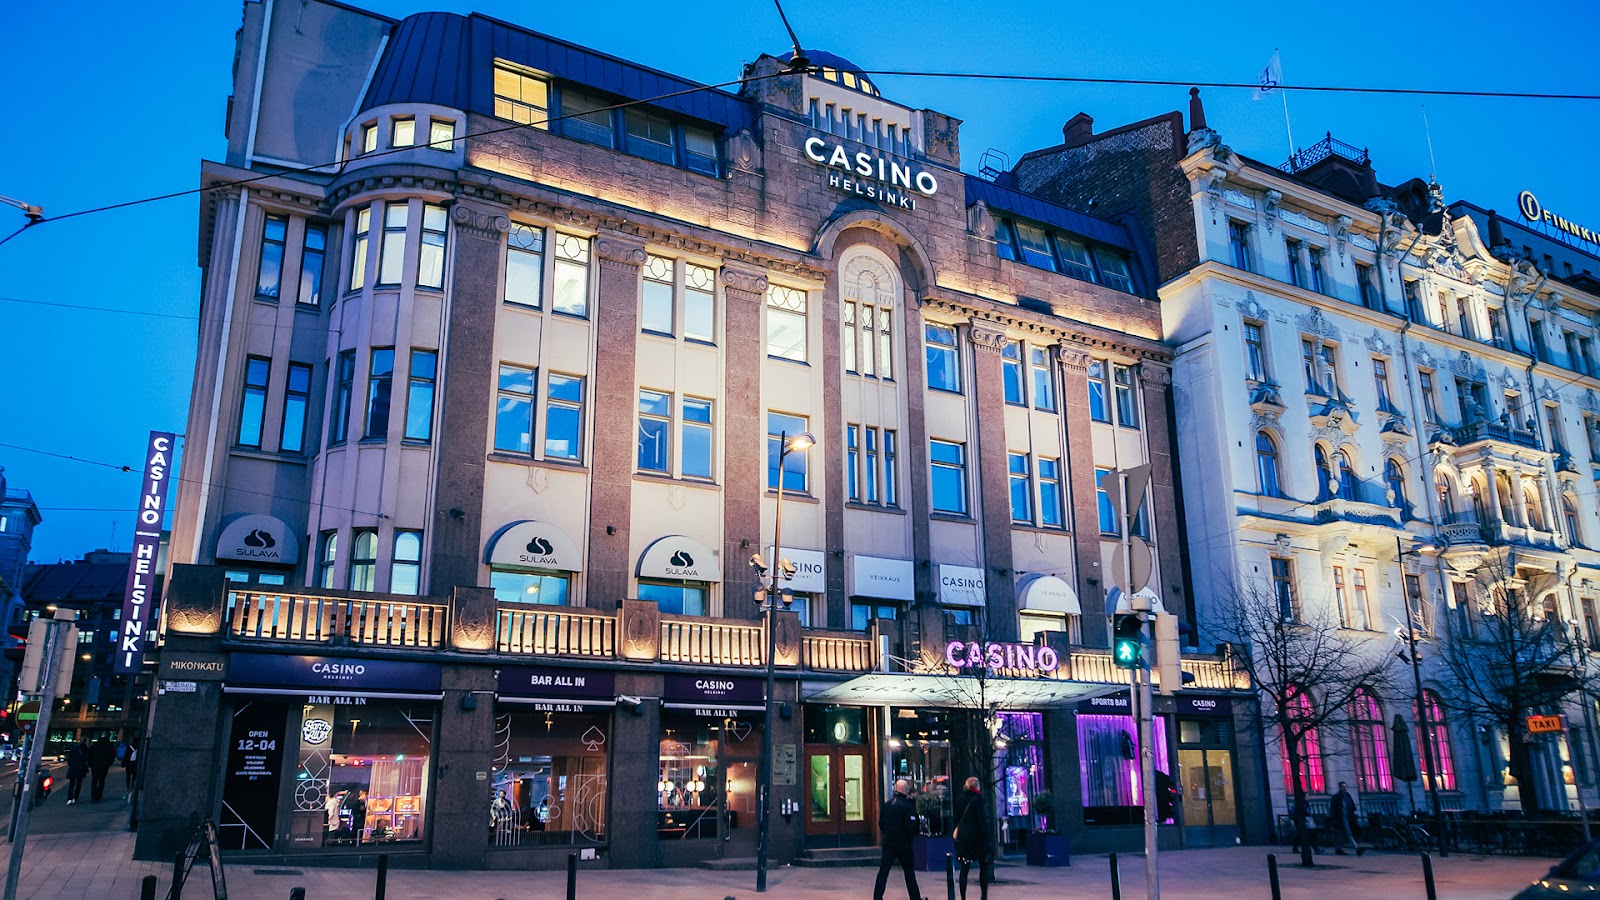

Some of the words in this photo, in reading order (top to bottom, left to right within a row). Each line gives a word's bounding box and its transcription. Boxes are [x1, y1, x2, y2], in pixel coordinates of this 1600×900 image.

[805, 137, 938, 195] CASINO
[829, 175, 916, 210] HELSINKI
[141, 437, 169, 524] CASINO
[236, 548, 279, 558] SULAVA
[519, 554, 558, 565] SULAVA
[665, 567, 699, 577] SULAVA
[791, 562, 822, 573] SINO
[869, 574, 901, 583] VEIKKAUS
[942, 576, 983, 589] CASINO
[122, 544, 154, 667] HELSINKI
[946, 641, 1058, 672] CASINO
[170, 661, 224, 671] MIKONKATU
[312, 663, 365, 675] CASINO
[531, 675, 552, 685] BAR
[554, 676, 573, 686] ALL
[575, 677, 585, 687] IN
[695, 680, 734, 690] CASINO
[308, 695, 331, 704] BAR
[333, 696, 353, 705] ALL
[355, 697, 367, 706] IN
[1091, 697, 1114, 706] SPORTS
[1115, 699, 1128, 707] BAR
[1192, 699, 1216, 707] CASINO
[534, 703, 553, 711] BAR
[555, 704, 572, 712] ALL
[695, 709, 712, 717] BAR
[713, 709, 728, 718] ALL
[729, 710, 738, 718] IN
[1533, 719, 1556, 729] TAXI
[248, 730, 269, 738] OPEN
[237, 739, 276, 751] 12-04
